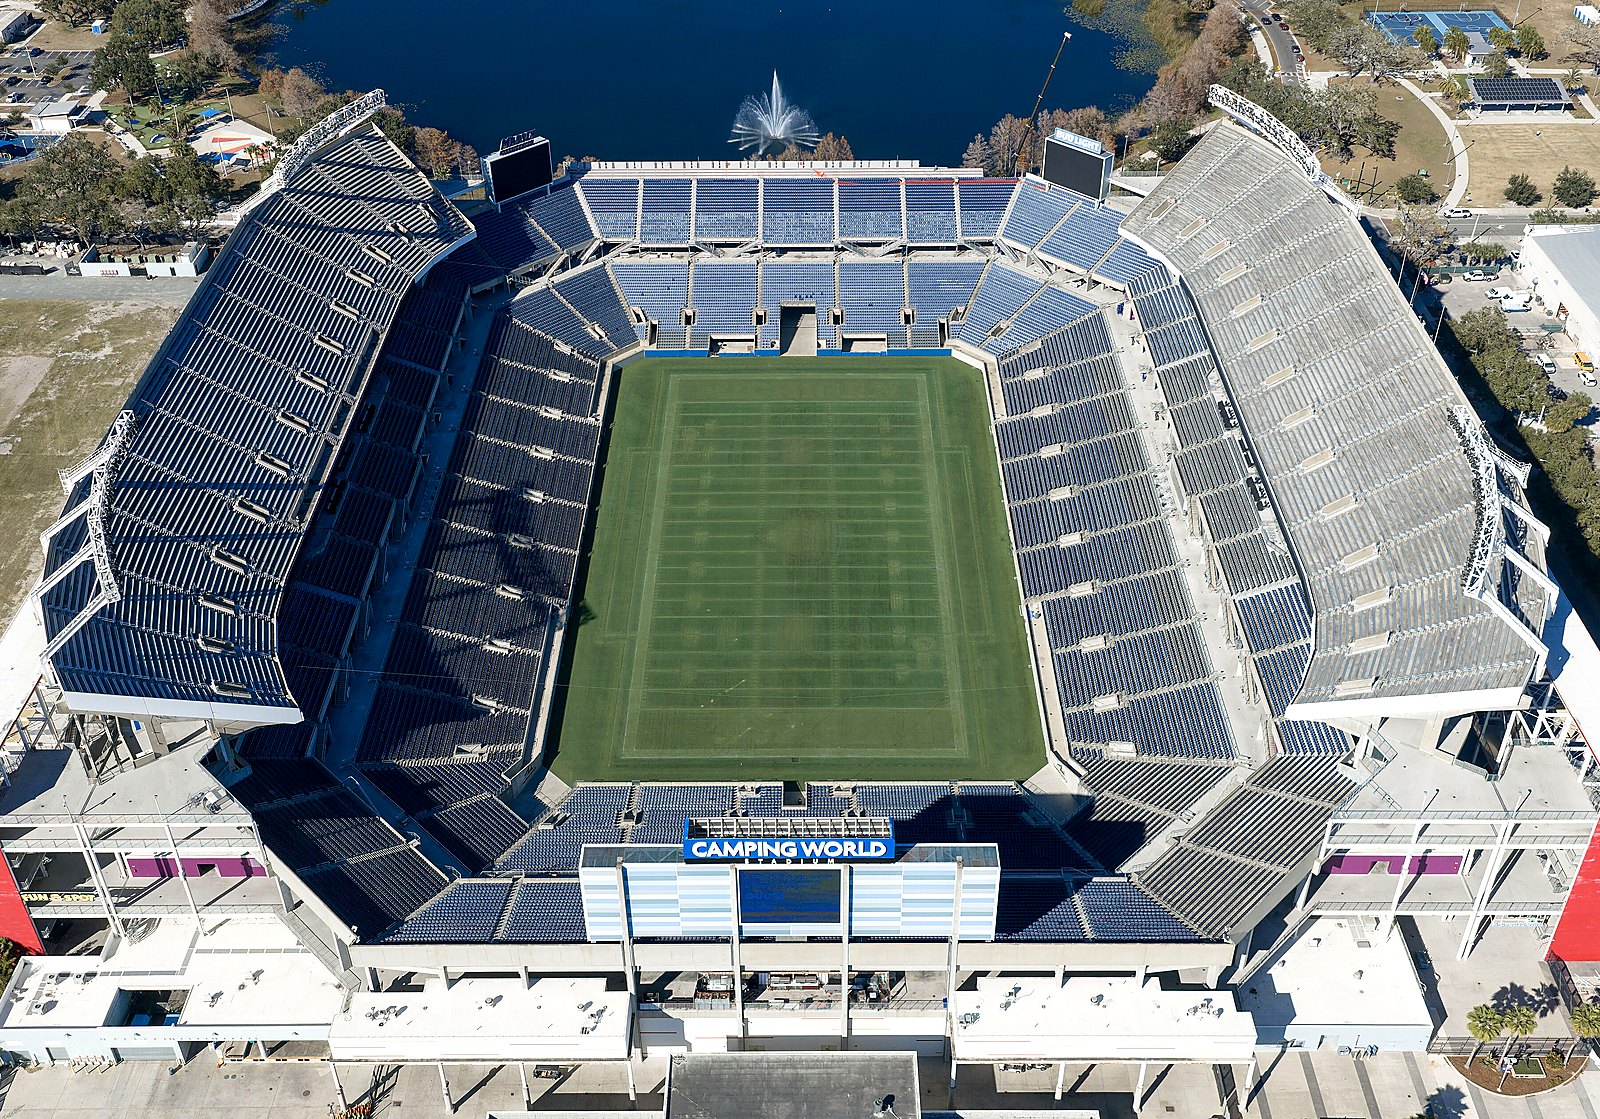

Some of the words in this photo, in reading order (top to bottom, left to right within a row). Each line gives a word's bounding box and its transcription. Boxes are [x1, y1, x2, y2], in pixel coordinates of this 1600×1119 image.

[1056, 131, 1074, 142] BUD
[1075, 136, 1099, 151] LIGHT
[691, 841, 798, 858] CAMPING
[800, 841, 887, 858] WORLD
[21, 893, 49, 902] FUN
[63, 893, 96, 902] SPOT
